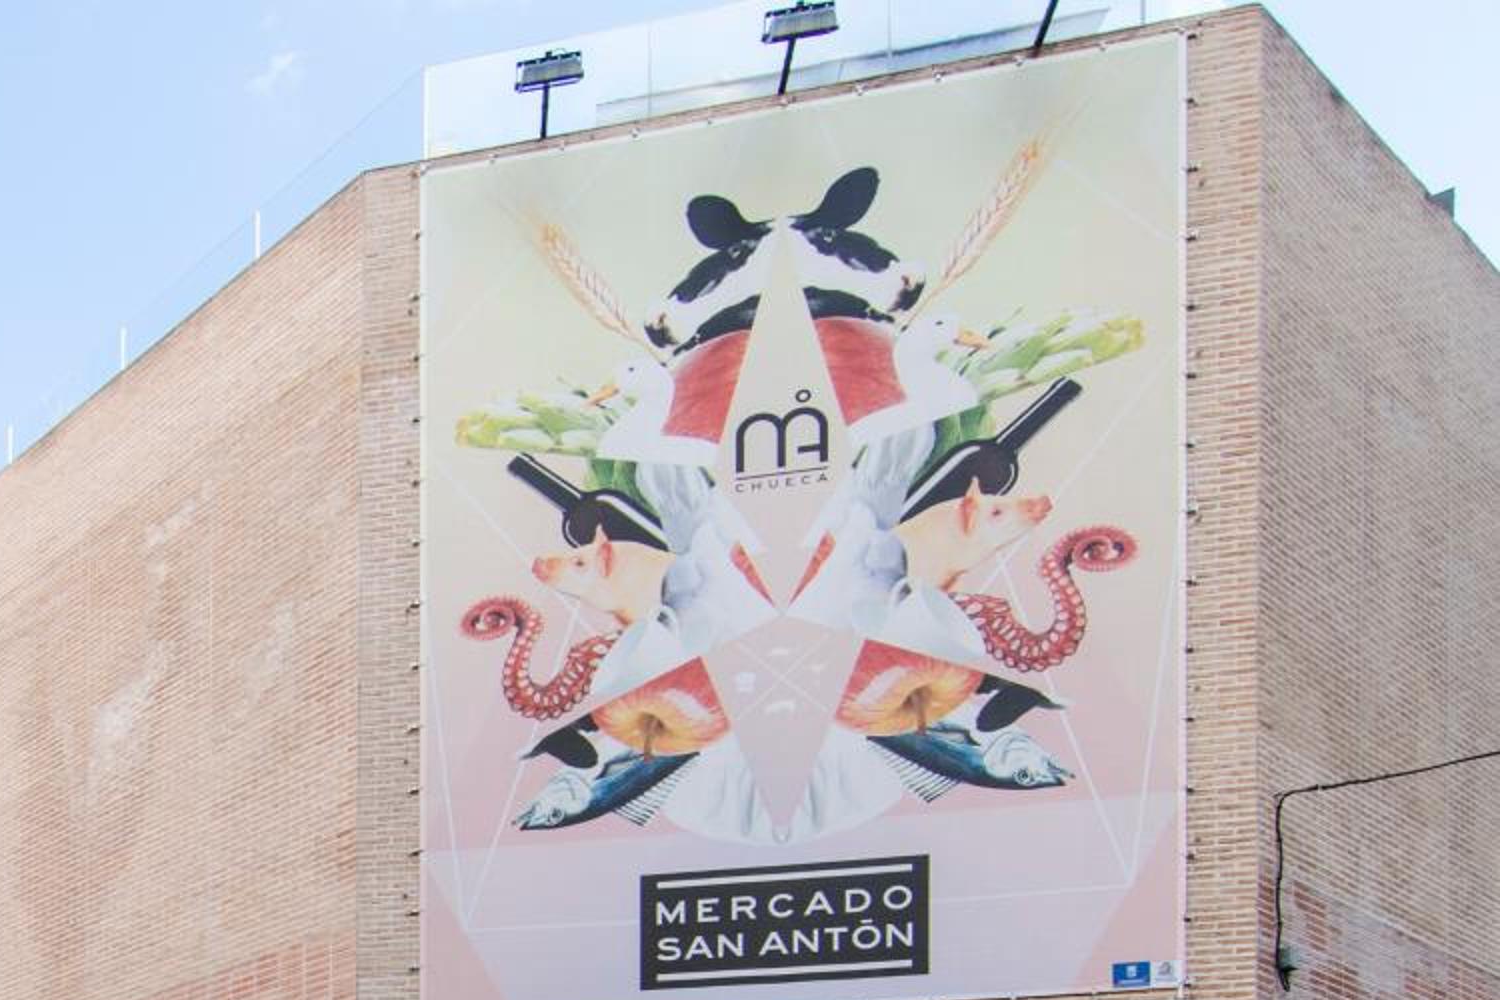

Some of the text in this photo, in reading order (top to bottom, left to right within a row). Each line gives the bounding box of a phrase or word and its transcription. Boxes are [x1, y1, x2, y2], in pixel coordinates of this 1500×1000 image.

[735, 473, 829, 493] CHUECA
[655, 885, 913, 926] MERCADO
[656, 931, 744, 961] SAN
